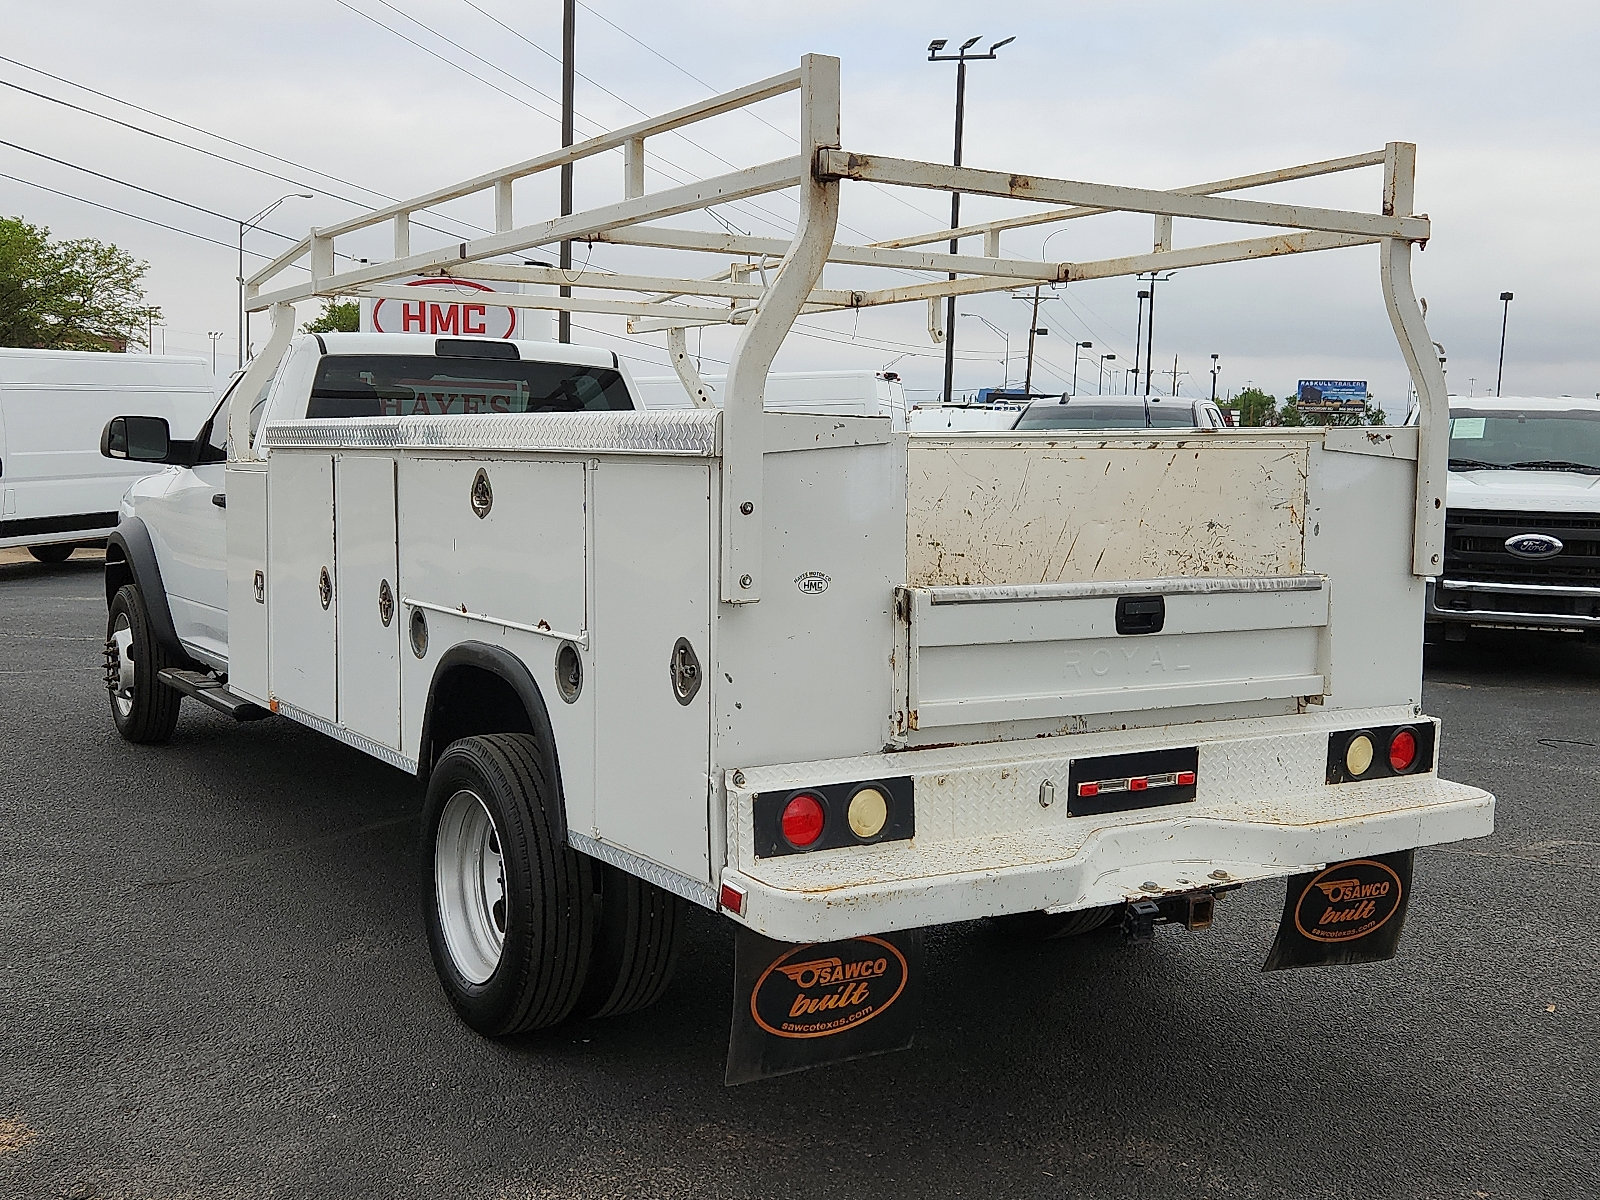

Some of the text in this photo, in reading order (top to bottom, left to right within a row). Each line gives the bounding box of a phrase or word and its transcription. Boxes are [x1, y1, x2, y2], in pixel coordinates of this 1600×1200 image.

[402, 301, 486, 335] HMC
[381, 393, 512, 415] HAYES
[1520, 540, 1548, 552] Ford
[803, 580, 823, 591] HMC
[1062, 645, 1192, 679] ROYAL
[1343, 881, 1390, 900] SAWCO
[1318, 900, 1376, 925] built
[1311, 920, 1376, 938] sawcotexas.com
[819, 958, 887, 984] SAWCO
[788, 982, 870, 1018] built
[781, 1005, 873, 1031] sawcotexas.com
